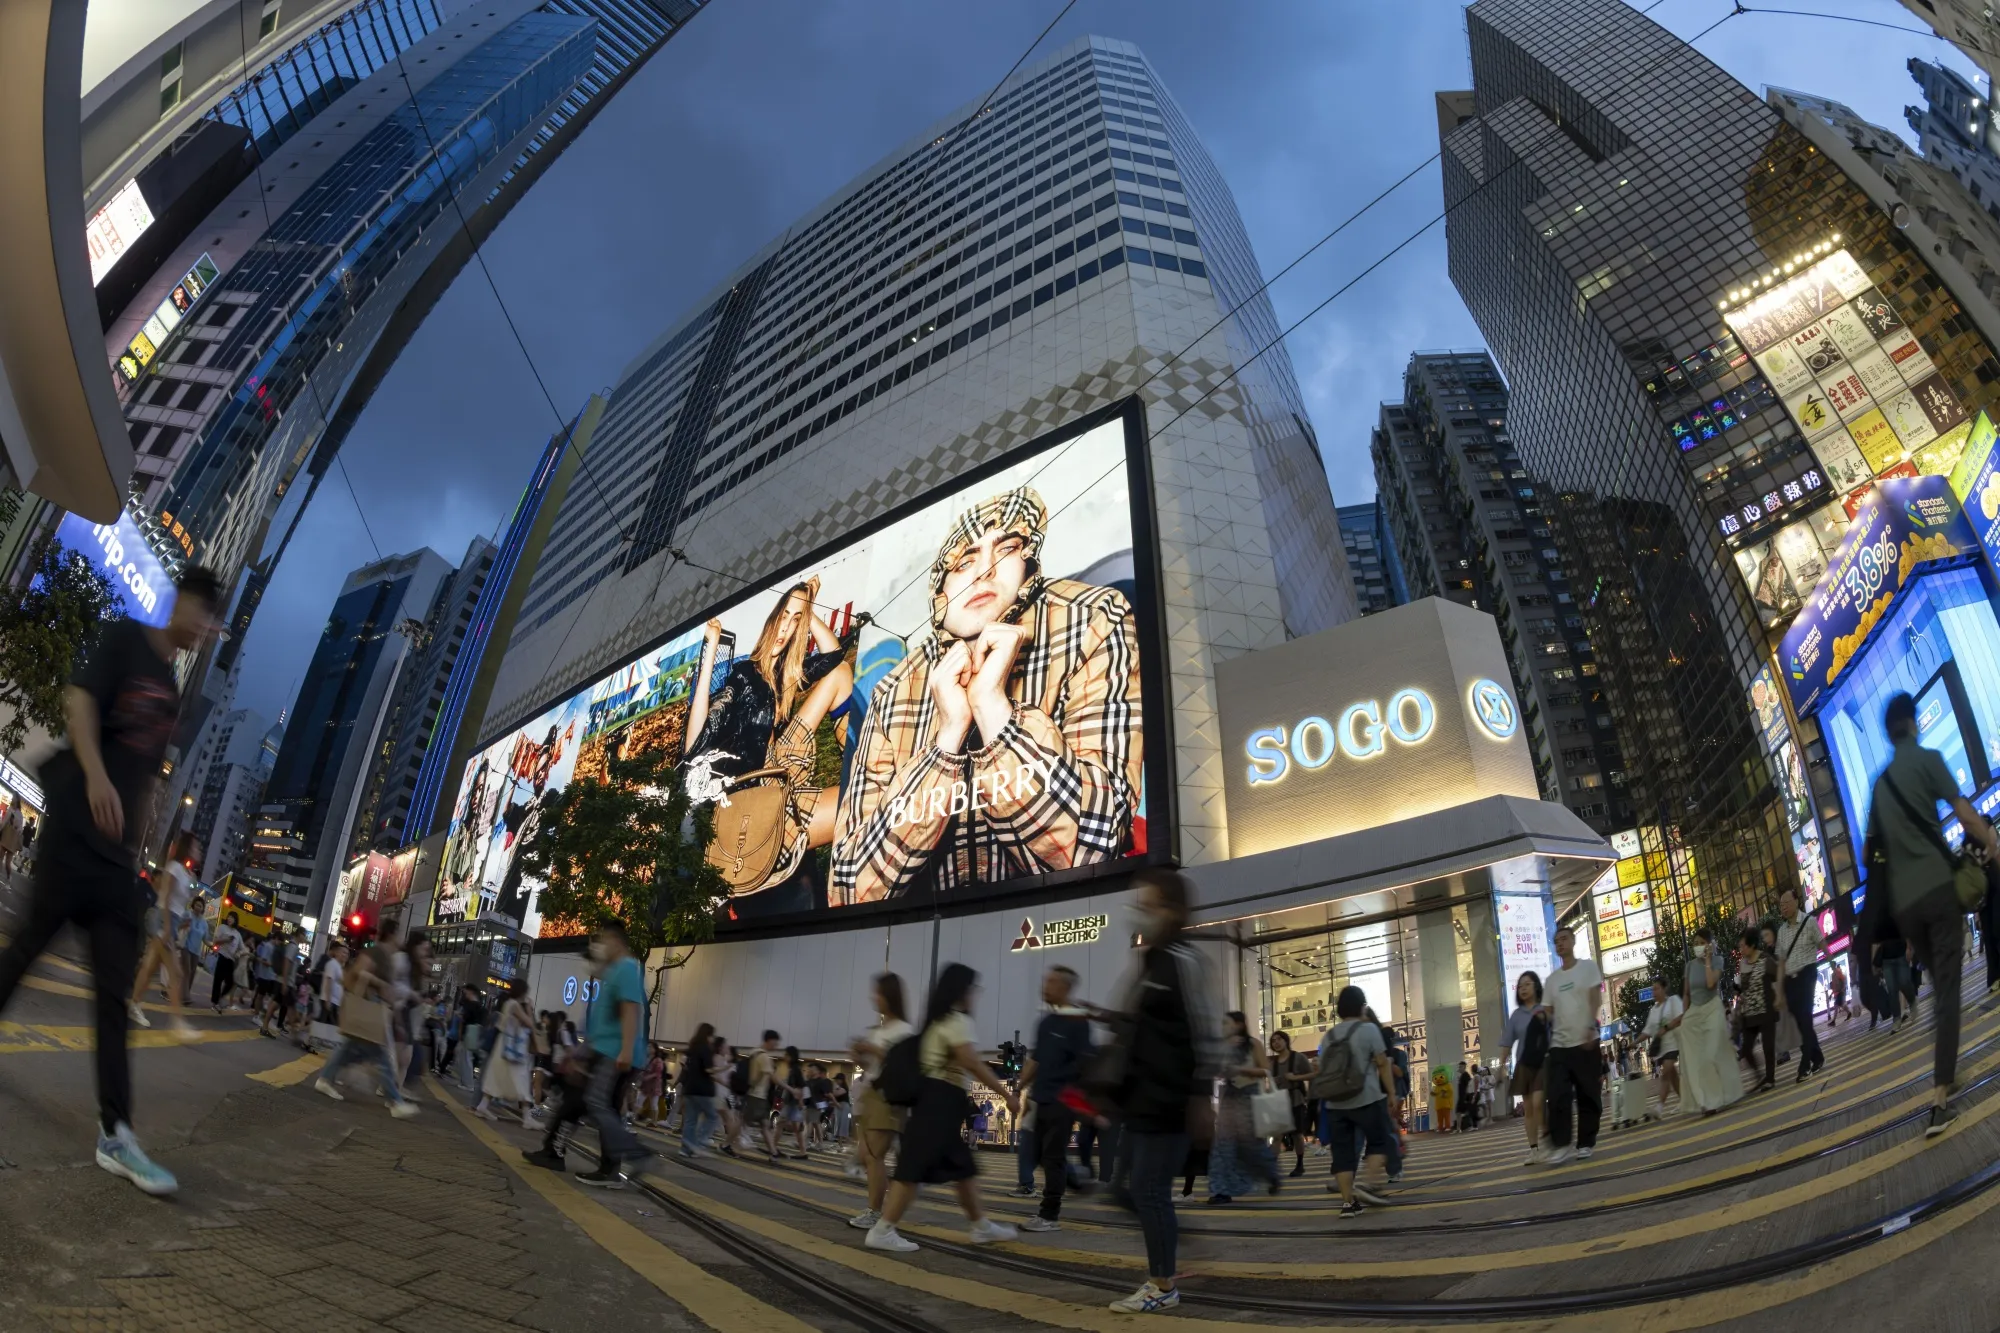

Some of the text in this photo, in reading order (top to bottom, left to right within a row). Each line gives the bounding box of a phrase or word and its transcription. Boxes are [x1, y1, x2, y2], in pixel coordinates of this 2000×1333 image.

[1899, 332, 1911, 343] 6/F
[1776, 342, 1789, 354] 7/F
[1884, 434, 1896, 445] 5/F
[1853, 460, 1865, 472] 5/F
[1720, 470, 1824, 536] 傷心酸辣粉
[1916, 494, 1944, 509] standard
[1921, 503, 1950, 517] chartered
[1796, 623, 1818, 656] standard
[1799, 630, 1822, 662] chartered
[1246, 688, 1434, 784] SOGO
[888, 756, 1061, 829] BURBERRY
[1044, 914, 1108, 935] MITSUBISHI
[1044, 928, 1099, 947] ELECTRIC
[1516, 942, 1533, 954] FUN
